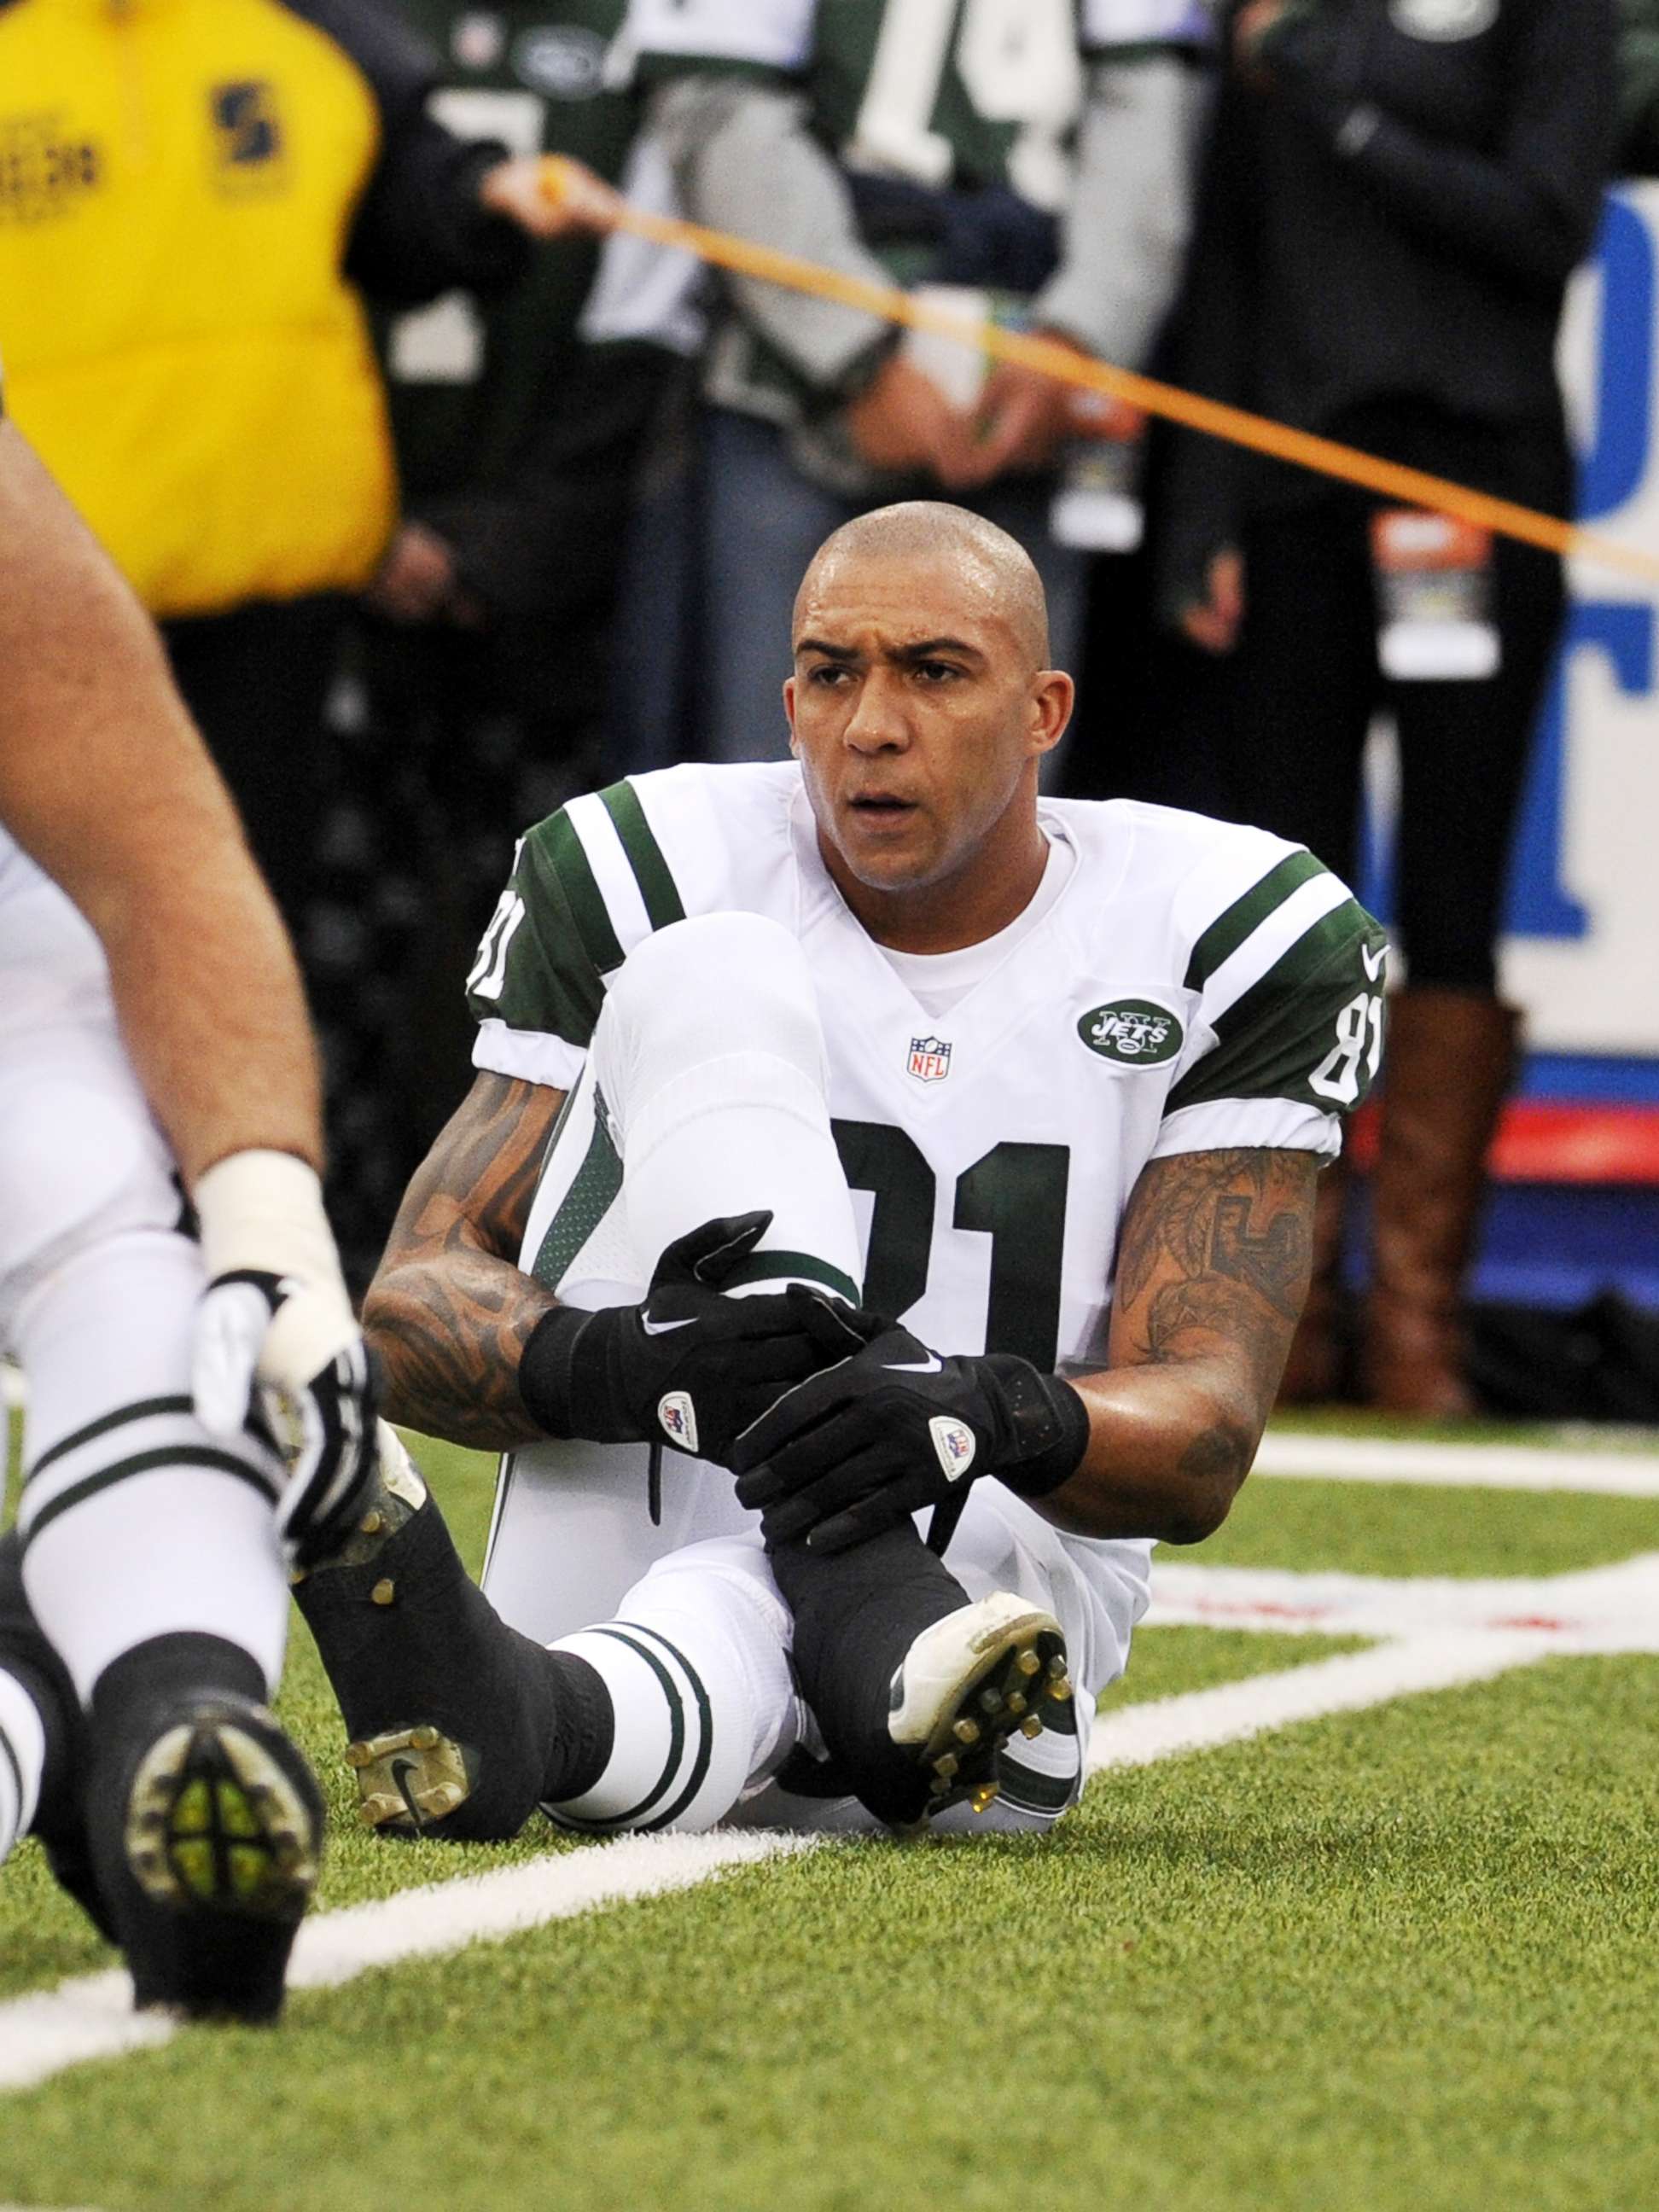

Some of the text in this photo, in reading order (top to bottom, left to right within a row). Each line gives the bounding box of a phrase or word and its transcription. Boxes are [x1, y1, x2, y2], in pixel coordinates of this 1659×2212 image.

[911, 1053, 944, 1077] NFL
[1091, 1017, 1168, 1043] JETS
[1308, 992, 1382, 1106] 81
[828, 1118, 1070, 1376] 1
